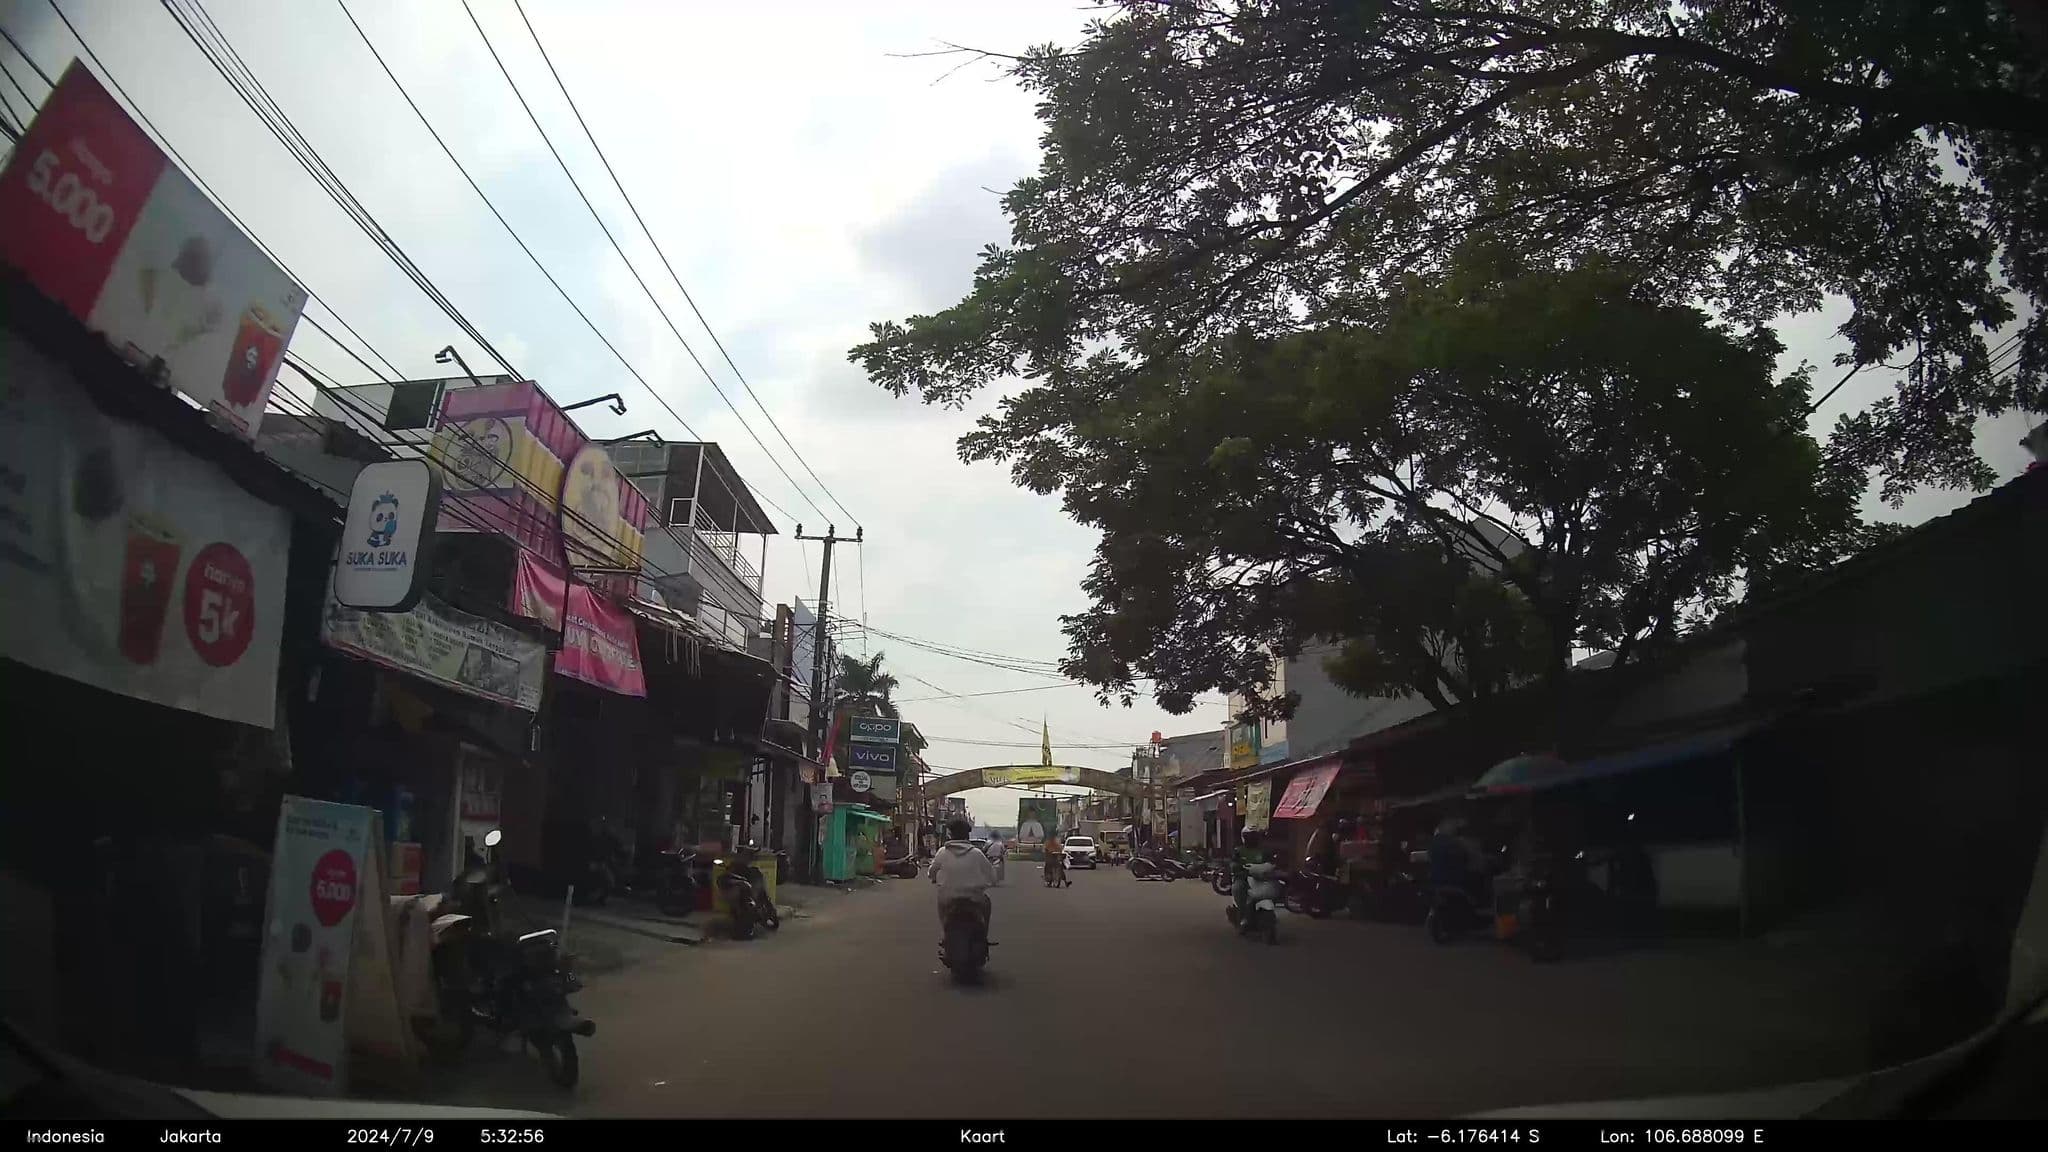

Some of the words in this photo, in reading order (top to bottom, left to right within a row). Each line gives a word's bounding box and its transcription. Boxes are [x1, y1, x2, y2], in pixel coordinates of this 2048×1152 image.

[27, 148, 115, 244] 5.000
[346, 551, 374, 566] SUKA
[377, 551, 407, 566] SUKA
[859, 722, 892, 733] oppo
[855, 750, 890, 762] vivo
